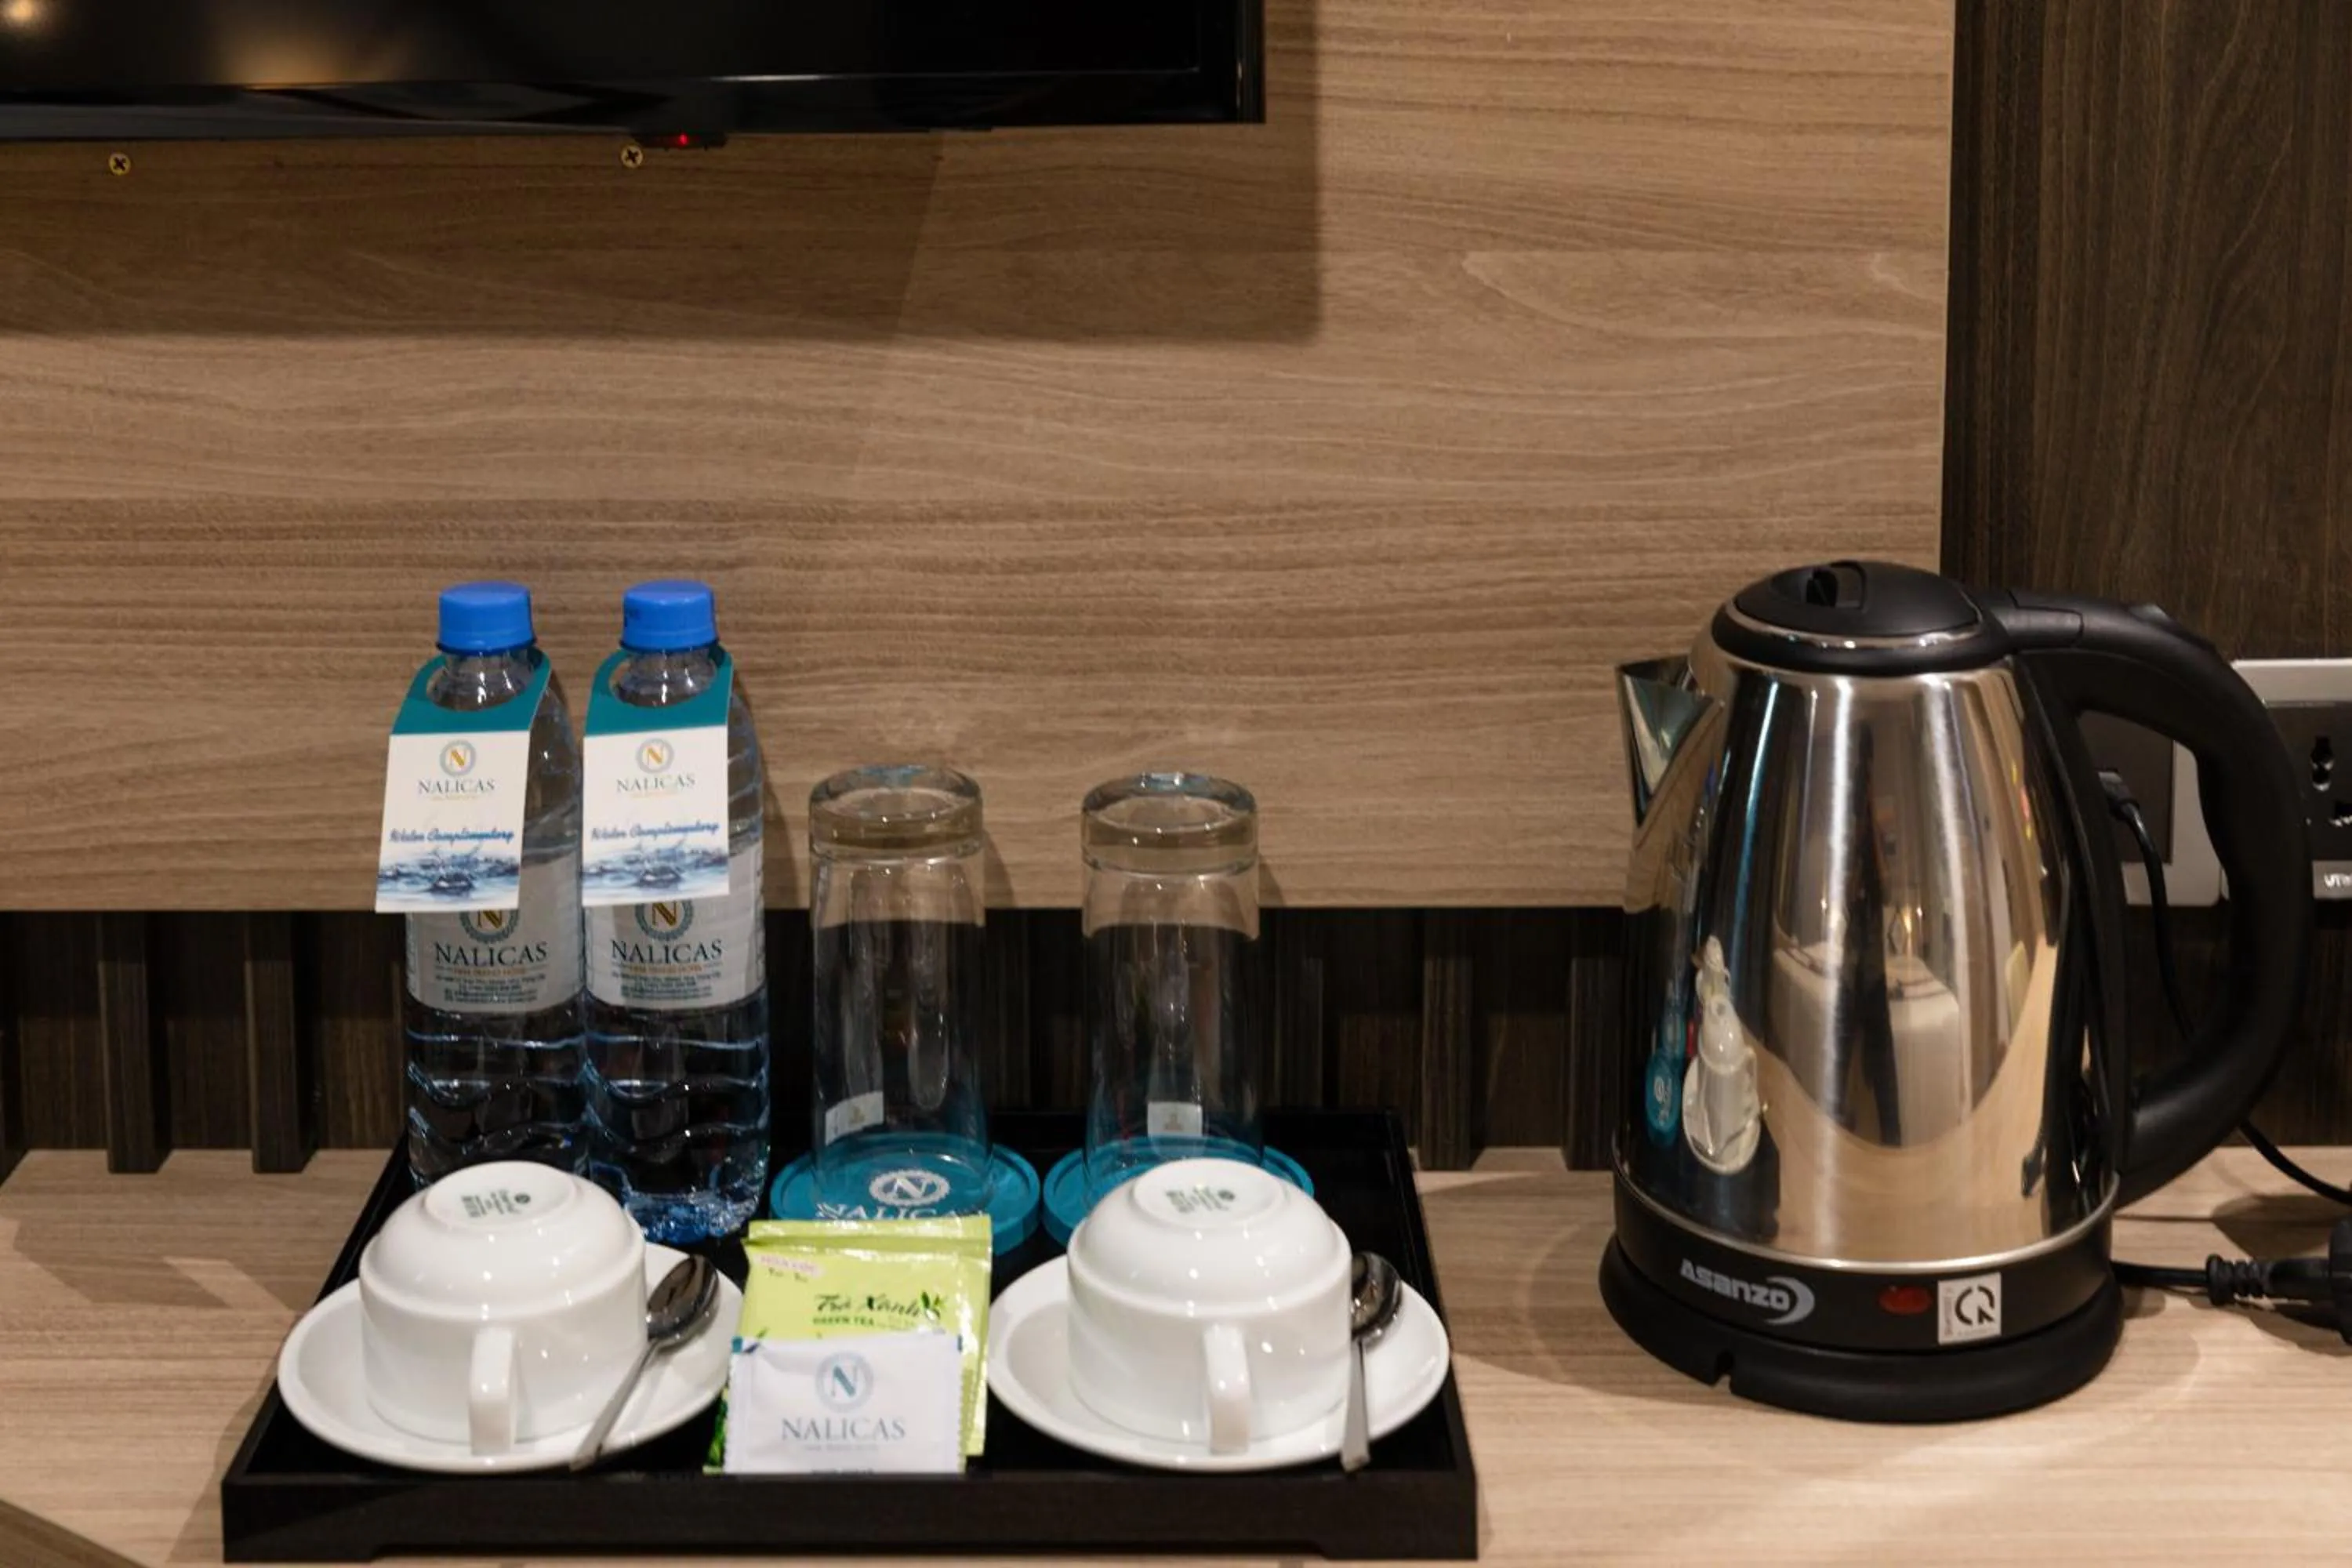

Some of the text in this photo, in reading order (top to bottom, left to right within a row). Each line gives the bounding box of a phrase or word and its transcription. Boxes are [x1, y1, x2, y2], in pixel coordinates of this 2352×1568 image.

[450, 749, 467, 768] N
[646, 746, 665, 765] N
[417, 779, 495, 794] NALICAS
[616, 772, 695, 792] NALICAS
[652, 901, 677, 927] N
[434, 941, 548, 967] NALICAS
[611, 938, 723, 964] NALICAS
[887, 1177, 932, 1198] N
[853, 1317, 875, 1327] TEA
[831, 1364, 858, 1397] N
[782, 1417, 906, 1441] NALICAS
